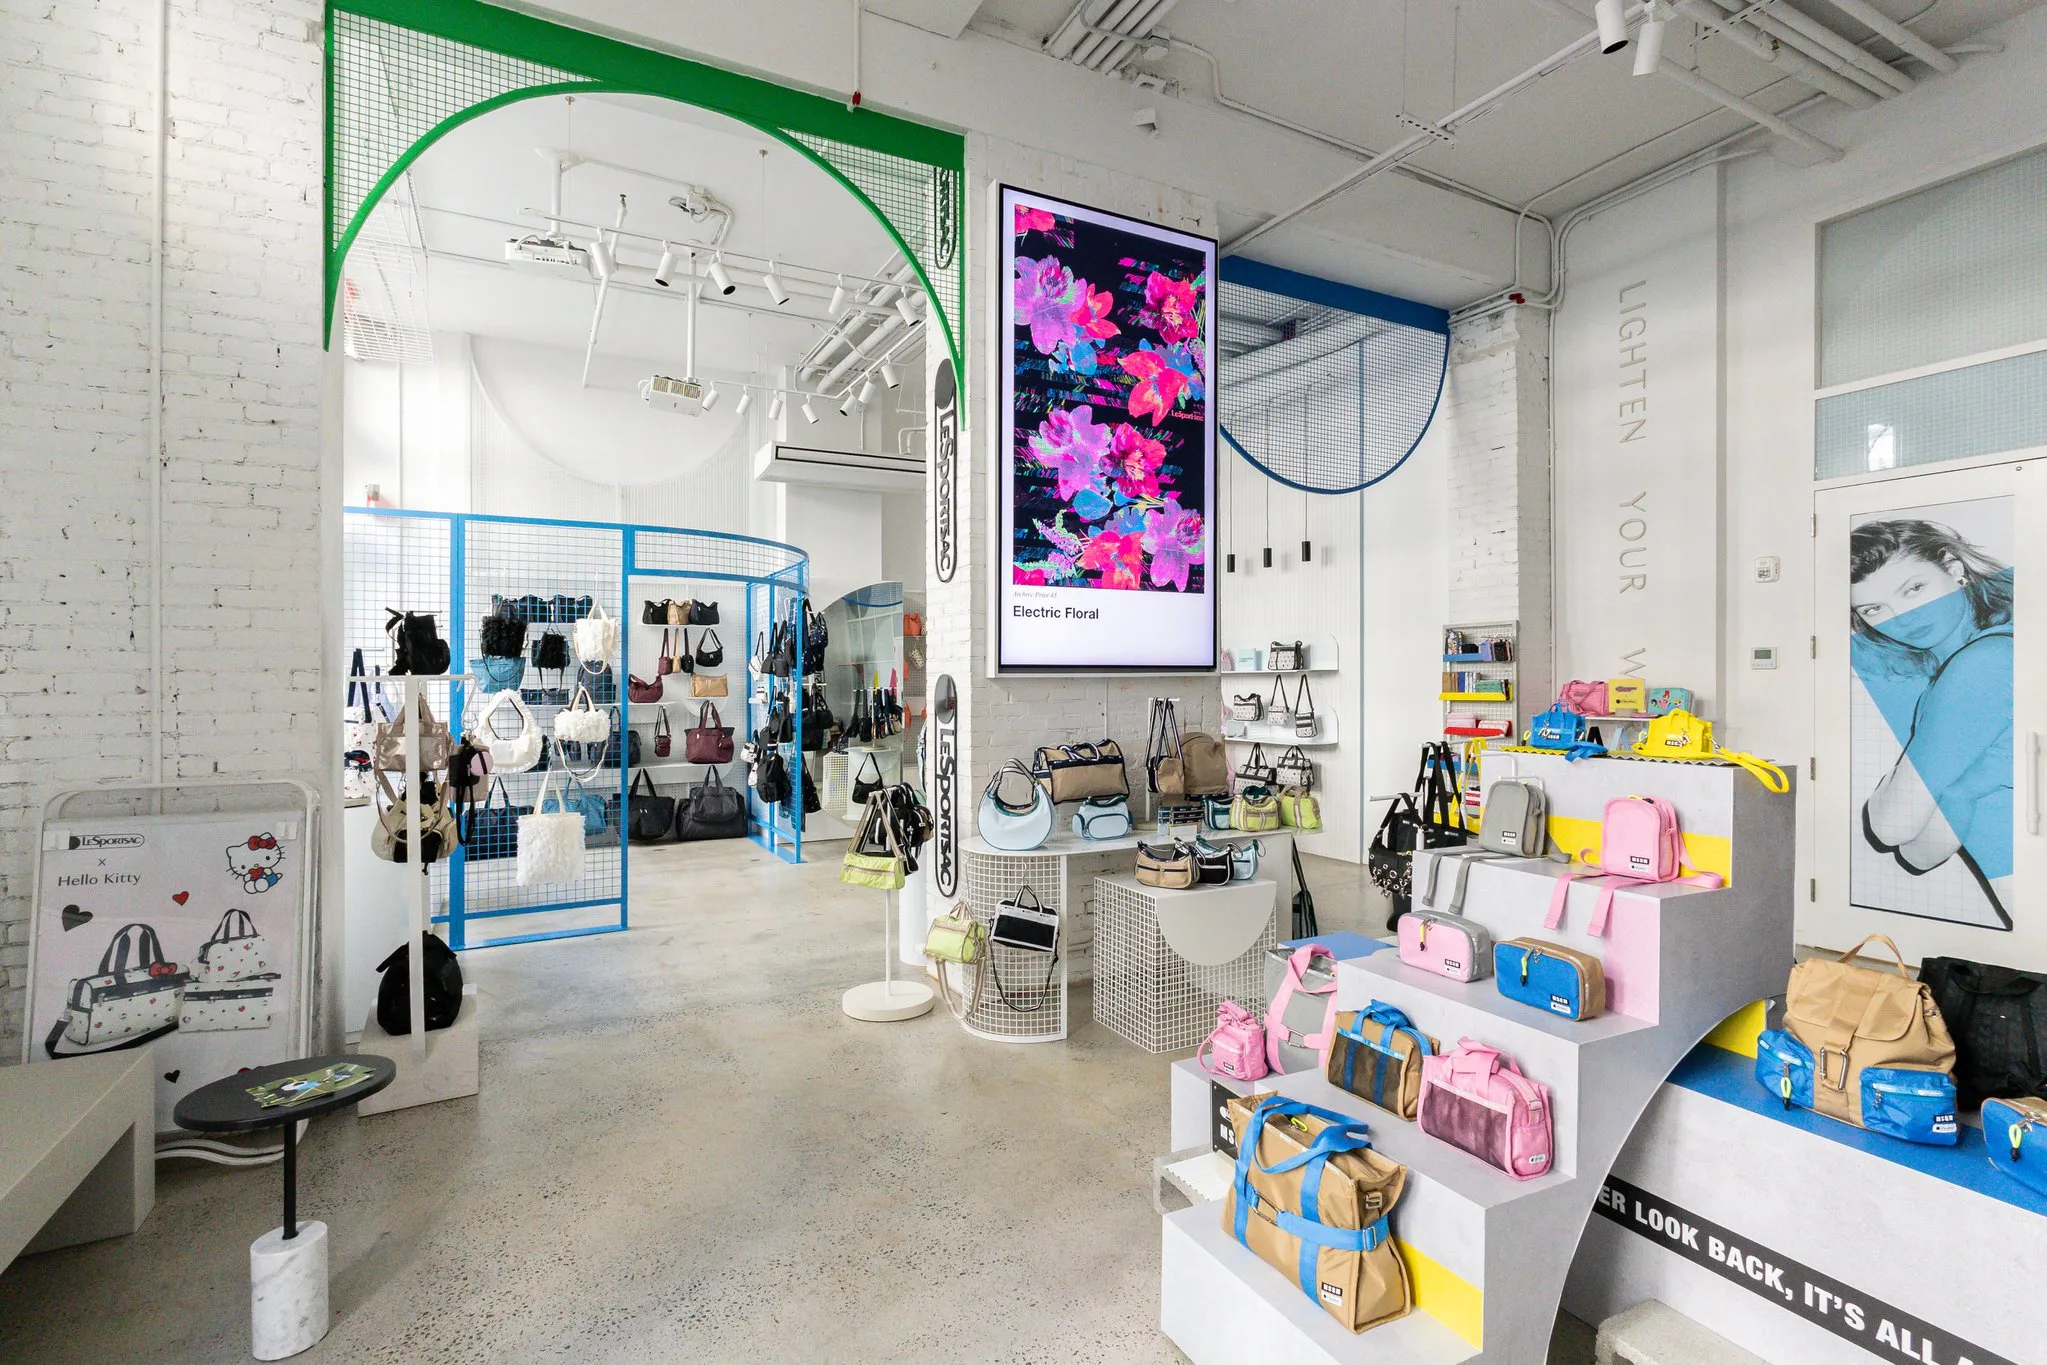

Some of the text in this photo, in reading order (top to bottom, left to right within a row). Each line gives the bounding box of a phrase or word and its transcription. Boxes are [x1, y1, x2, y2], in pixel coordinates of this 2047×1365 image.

[1619, 279, 1647, 445] LIGHTEN
[1619, 490, 1647, 595] YOUR
[1013, 605, 1099, 620] Electric Floral
[58, 872, 141, 887] Hello Kitty
[1220, 1124, 1238, 1148] MS
[1635, 1200, 1700, 1251] LOOK
[1708, 1235, 1795, 1301] BACK,
[1804, 1282, 1865, 1330] IT'S
[1875, 1318, 1940, 1365] ALL
